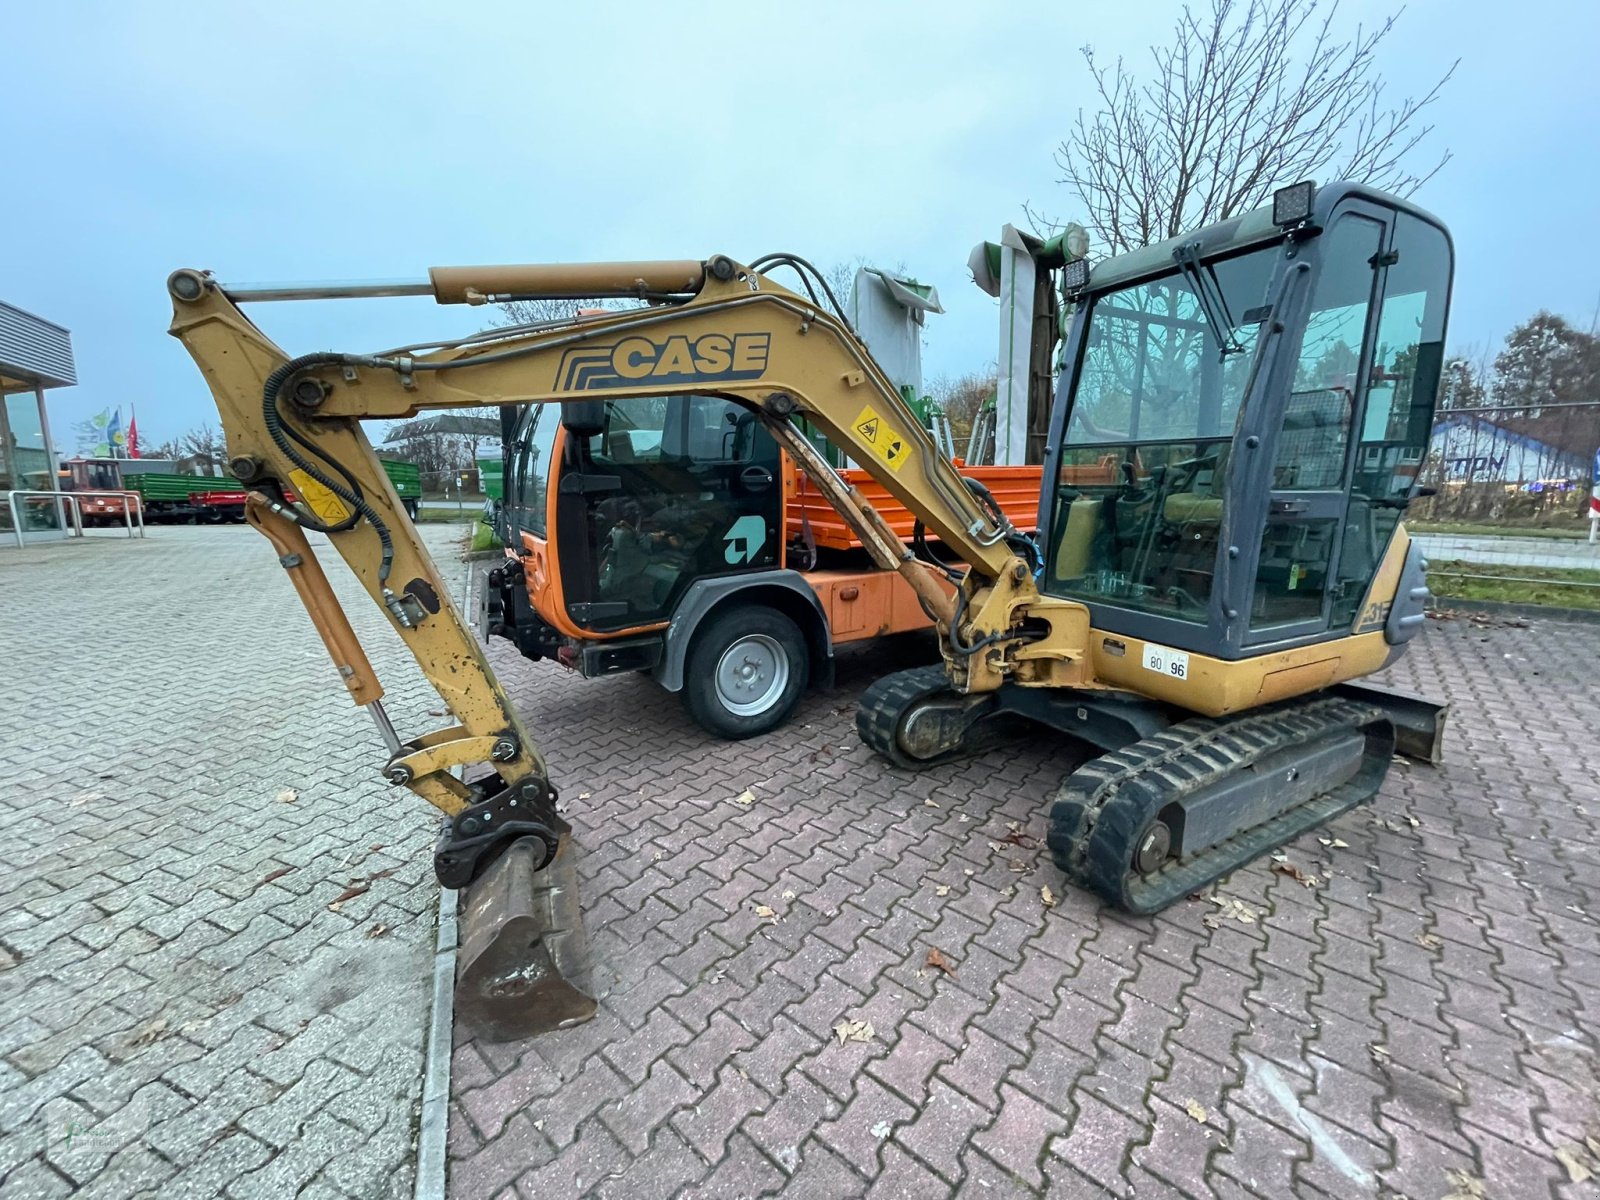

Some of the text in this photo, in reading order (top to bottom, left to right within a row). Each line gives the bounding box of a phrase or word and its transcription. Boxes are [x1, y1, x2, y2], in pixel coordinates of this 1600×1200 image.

[611, 333, 771, 379] CASE
[1150, 656, 1162, 670] 80
[1170, 662, 1185, 677] 96
